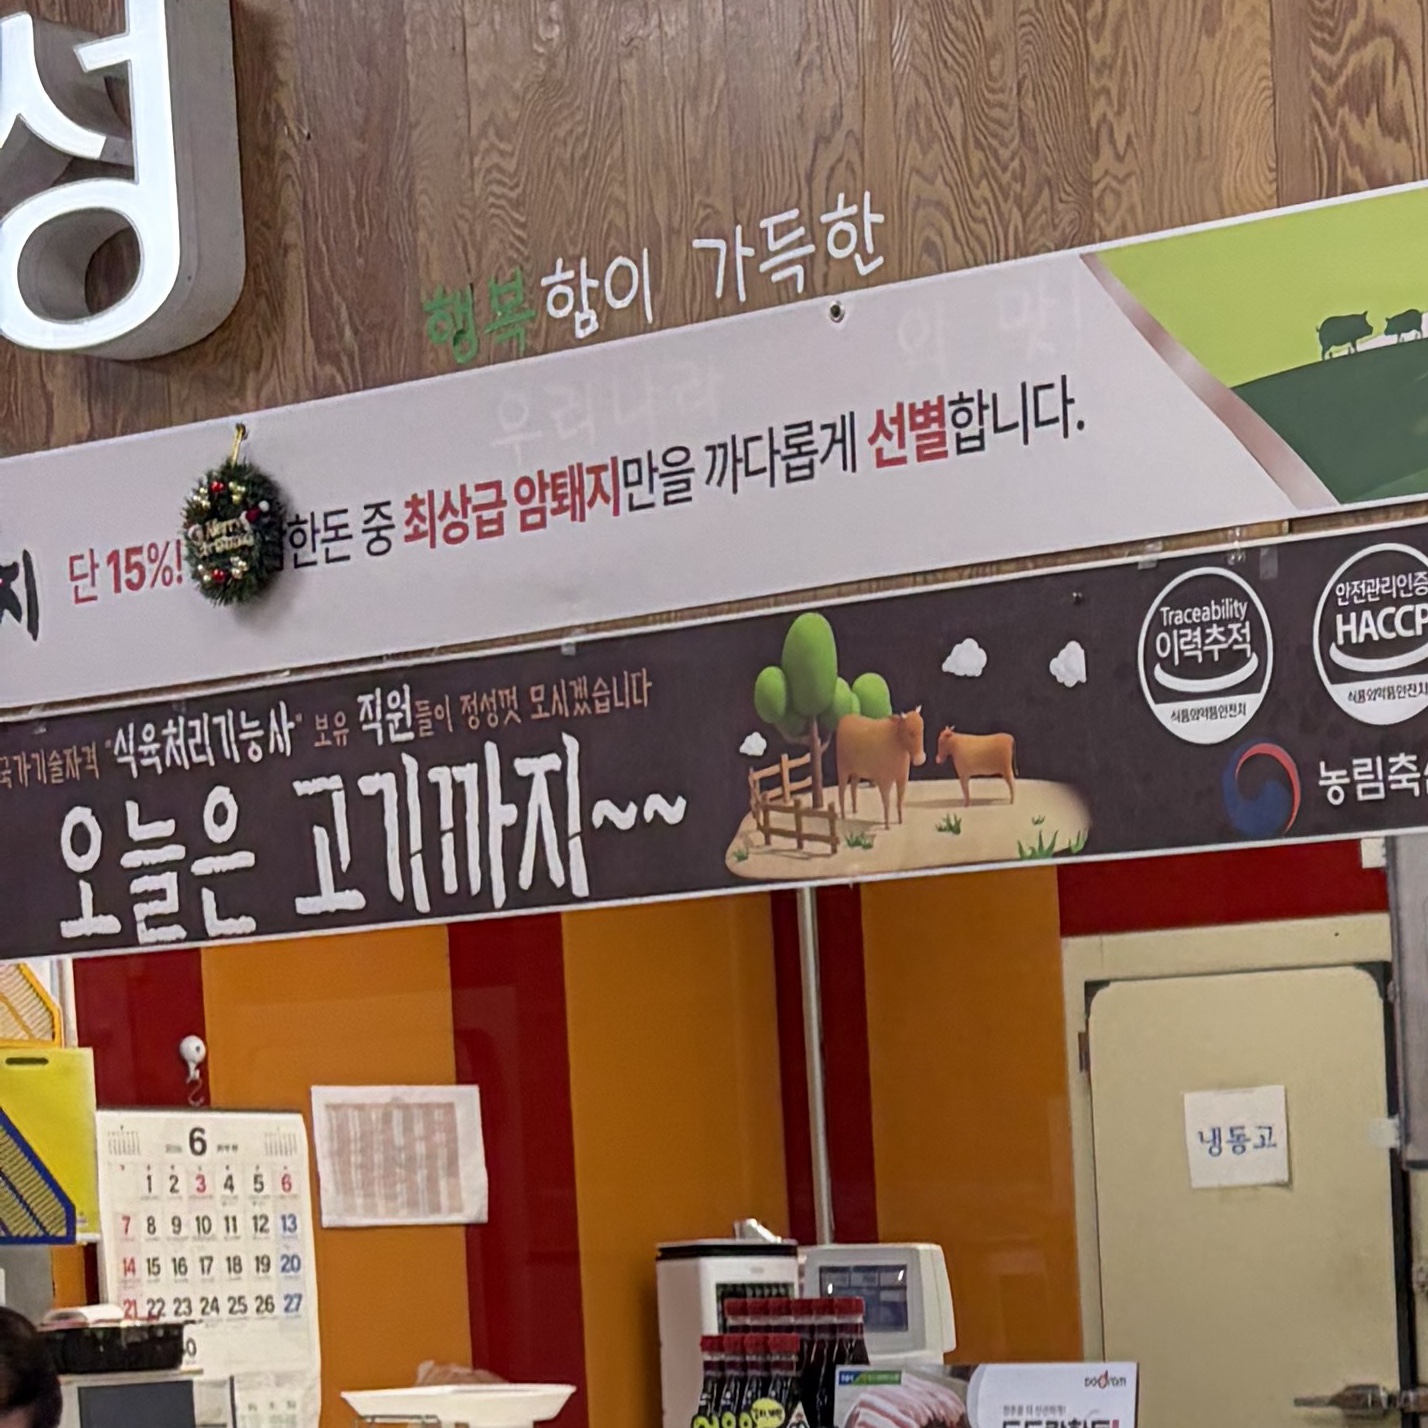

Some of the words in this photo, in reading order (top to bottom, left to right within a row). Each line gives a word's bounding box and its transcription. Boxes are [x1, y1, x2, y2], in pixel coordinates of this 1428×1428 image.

[422, 247, 655, 364] 행복함이
[691, 190, 885, 304] 가득한
[68, 550, 99, 606] 단
[106, 536, 184, 596] 15%!
[361, 501, 395, 556] 중
[404, 479, 508, 551] 최상급
[514, 444, 695, 535] 암퇘지만을
[705, 411, 858, 499] 까다롭게
[867, 375, 1086, 469] 선별합니다.
[1160, 598, 1249, 628] Traceability
[1155, 620, 1253, 668] 이력추적
[313, 713, 350, 749] 보유
[357, 682, 454, 748] 직원들이
[529, 667, 653, 721] 모시겠습니다
[60, 784, 257, 946] 오늘은
[188, 1126, 209, 1157] 6
[1197, 1122, 1278, 1158] 냉동고
[147, 1174, 152, 1193] 1
[169, 1174, 179, 1194] 2
[196, 1174, 207, 1194] 3
[223, 1174, 235, 1194] 4
[253, 1174, 265, 1194] 5
[281, 1173, 293, 1193] 6
[122, 1215, 131, 1235] 7
[147, 1215, 156, 1235] 8
[171, 1215, 182, 1235] 9
[195, 1215, 212, 1235] 10
[224, 1215, 237, 1235] 11
[252, 1214, 270, 1234] 12
[281, 1213, 298, 1233] 13
[122, 1257, 136, 1276] 14
[146, 1257, 161, 1276] 15
[171, 1257, 188, 1276] 16
[199, 1256, 214, 1276] 17
[226, 1255, 242, 1275] 18
[255, 1254, 271, 1274] 19
[280, 1254, 301, 1274] 20
[173, 1299, 193, 1317] 23
[200, 1297, 220, 1316] 24
[227, 1295, 248, 1315] 25
[255, 1294, 275, 1314] 26
[283, 1293, 303, 1314] 27
